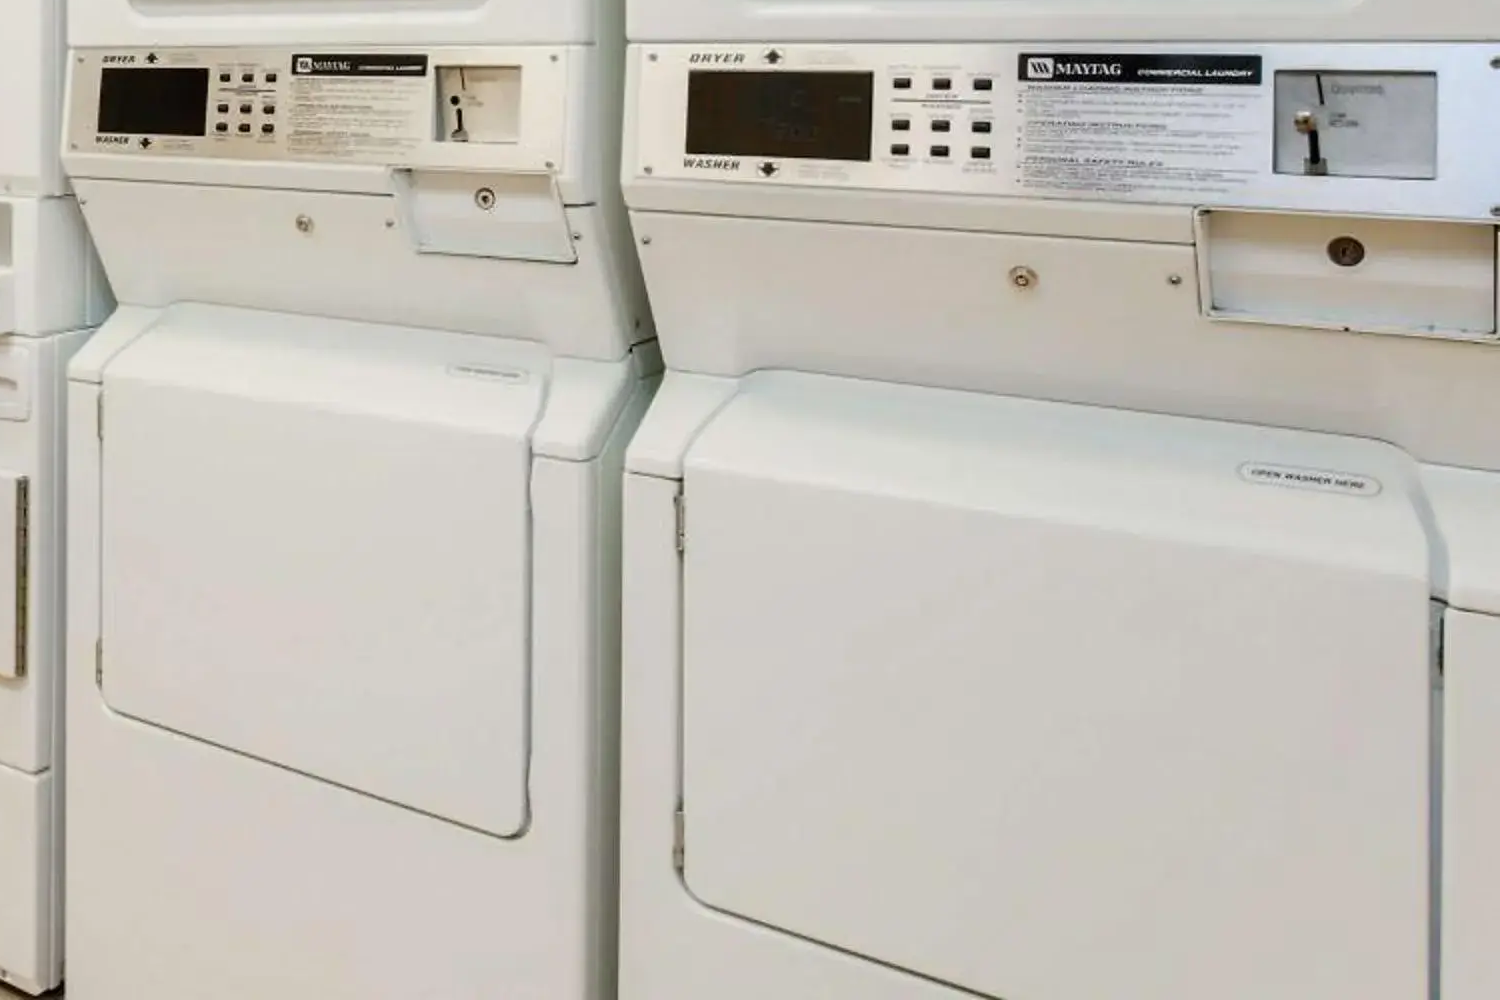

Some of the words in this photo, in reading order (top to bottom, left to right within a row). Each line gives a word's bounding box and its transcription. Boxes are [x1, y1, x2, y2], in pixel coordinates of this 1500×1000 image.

[689, 52, 746, 64] DRYER
[1056, 62, 1121, 76] MAYTAG
[1137, 68, 1202, 78] COMMERCIAL
[1205, 69, 1253, 78] LAUNDRY
[683, 158, 741, 171] WASHER
[1251, 468, 1281, 479] OPEN
[1285, 473, 1332, 486] WASHER
[1335, 479, 1365, 489] HERE
